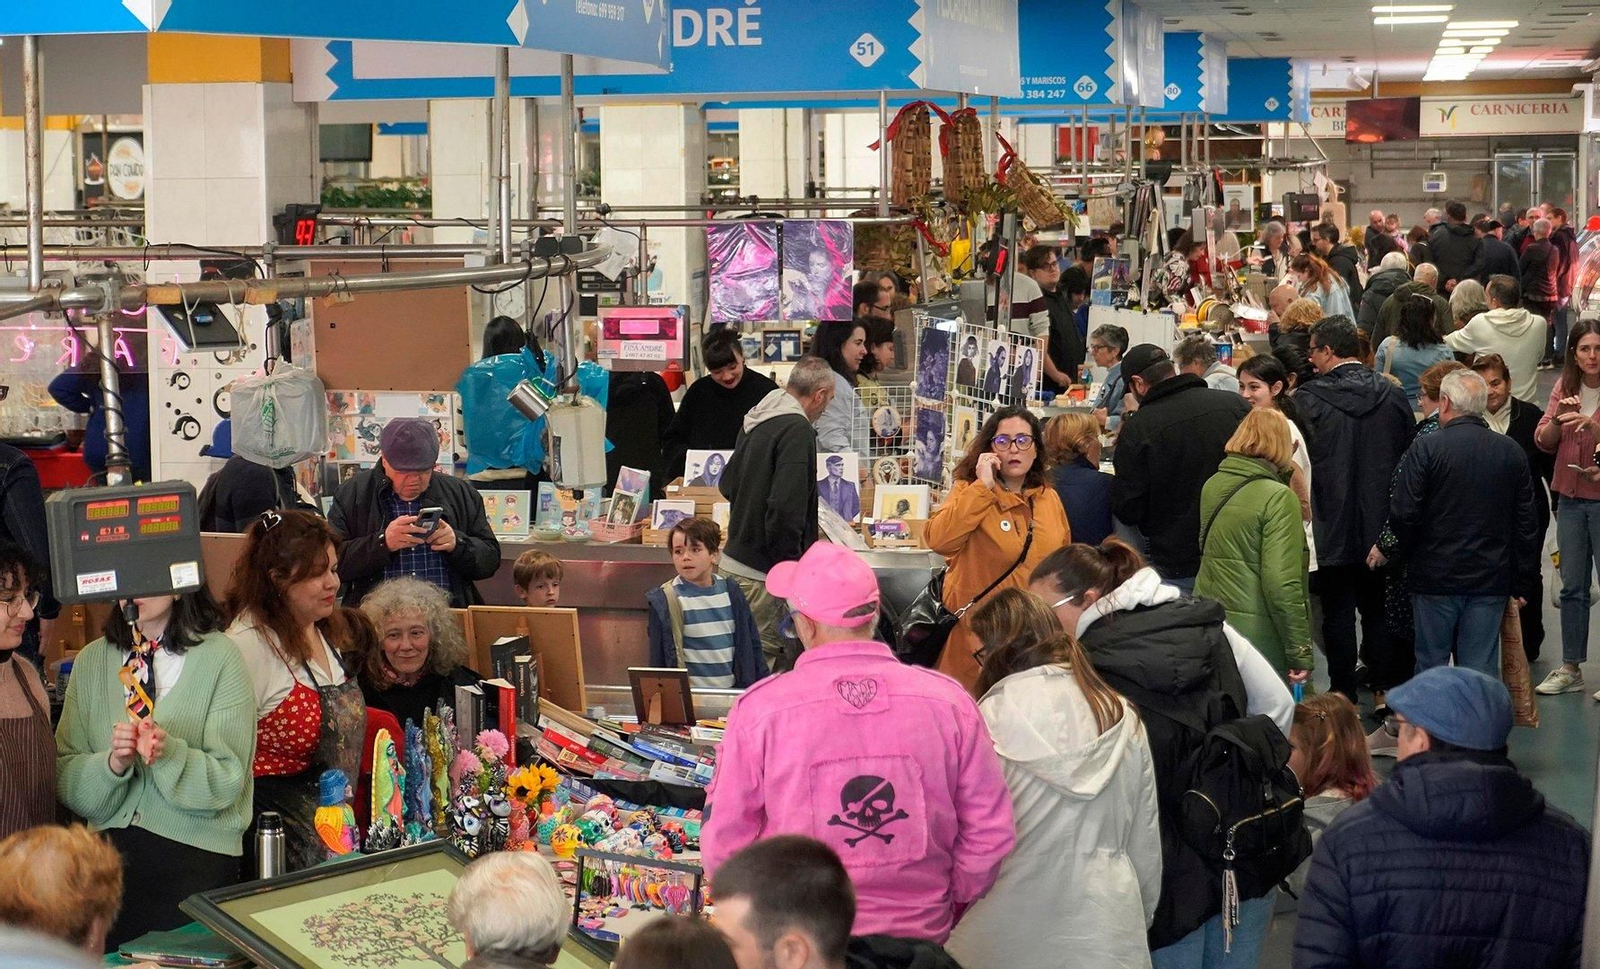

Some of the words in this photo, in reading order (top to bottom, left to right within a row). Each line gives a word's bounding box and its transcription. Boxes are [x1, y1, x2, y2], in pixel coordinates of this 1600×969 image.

[856, 42, 875, 56] 51
[1031, 76, 1067, 85] MARISCOS
[1077, 82, 1093, 92] 66
[1166, 87, 1178, 95] 80
[1026, 89, 1046, 99] 384
[1047, 89, 1066, 99] 247
